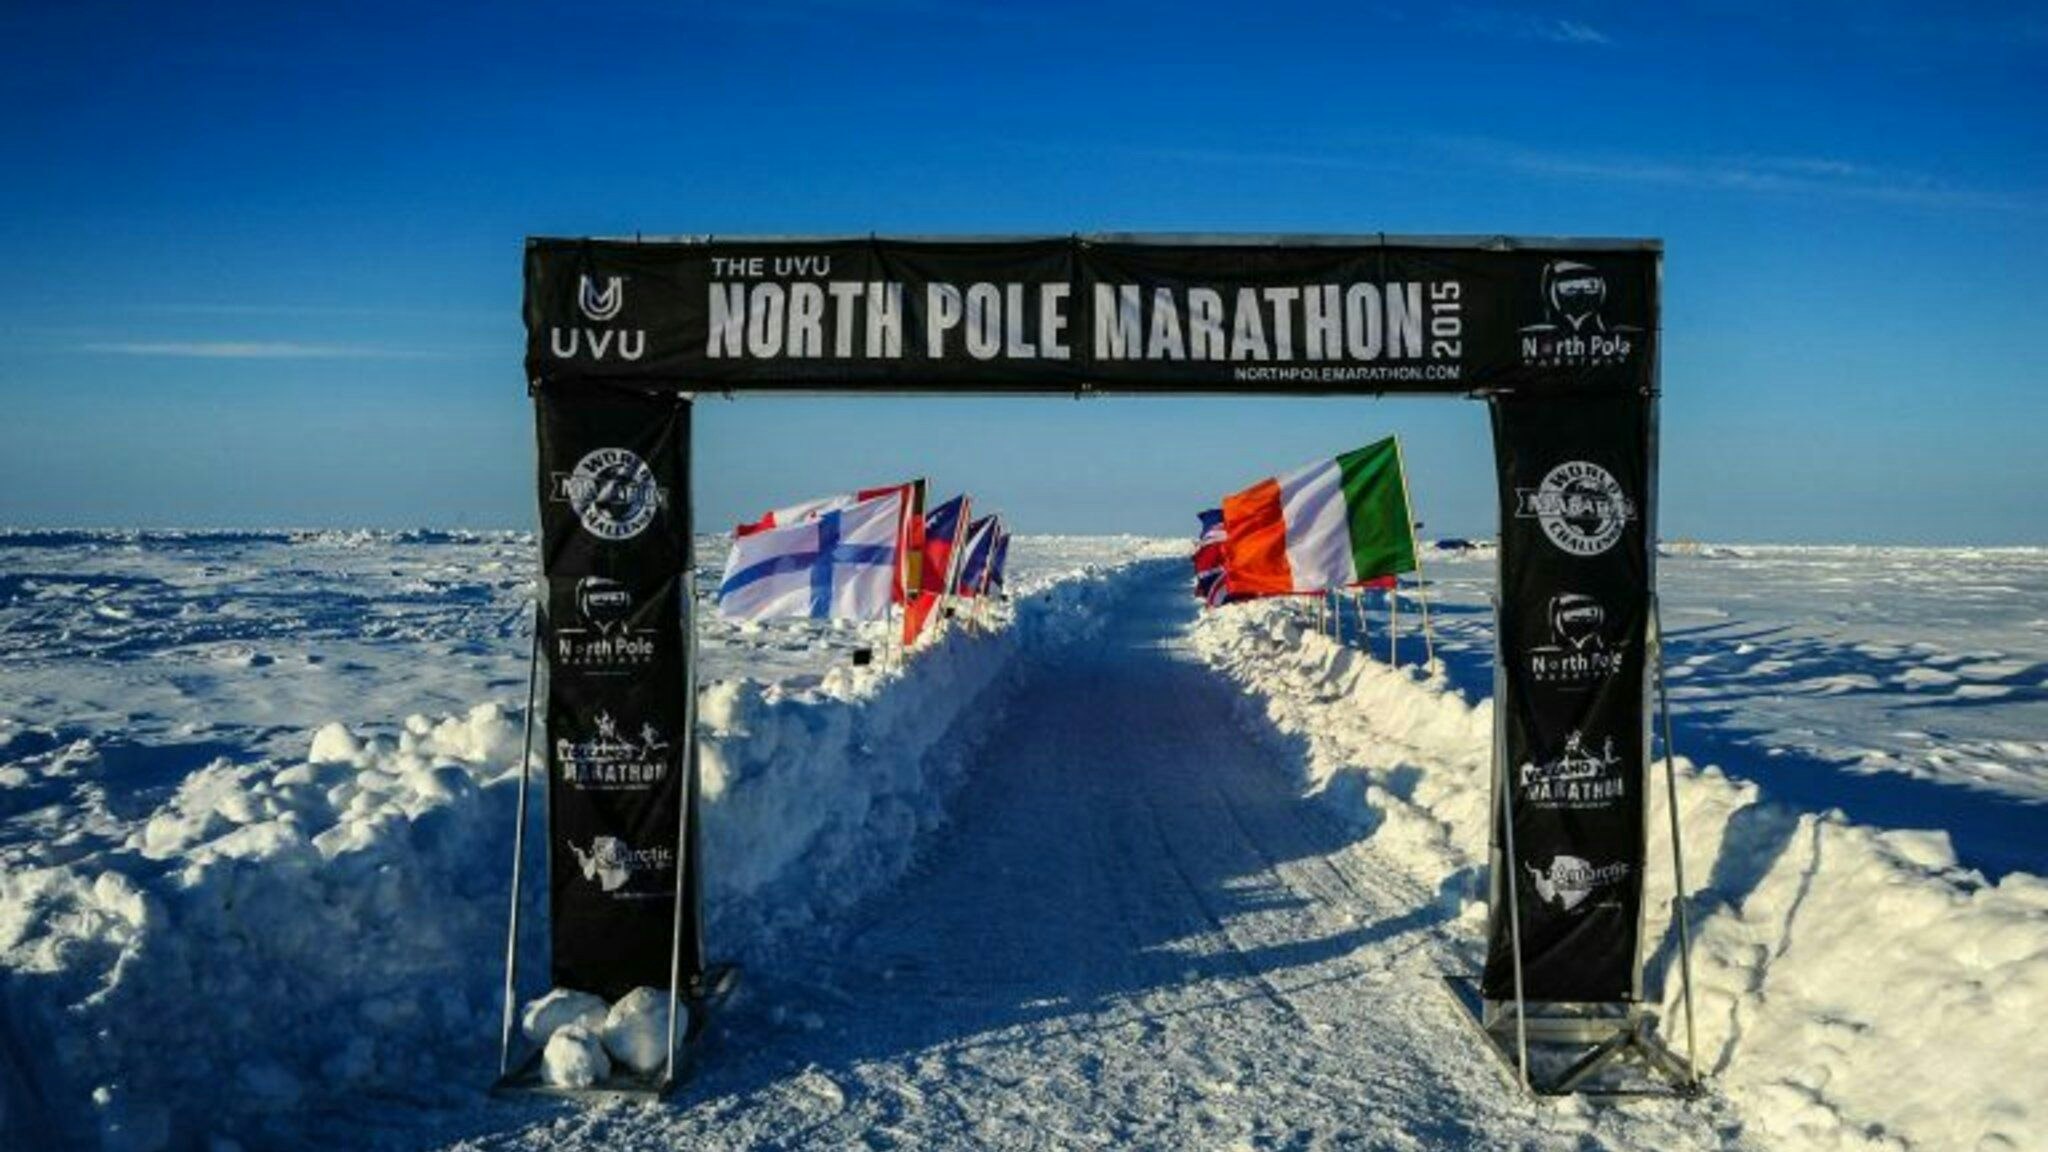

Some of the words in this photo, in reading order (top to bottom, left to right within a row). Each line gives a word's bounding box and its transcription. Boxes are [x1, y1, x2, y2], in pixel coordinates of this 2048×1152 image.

[711, 257, 764, 277] THE
[774, 256, 830, 276] UVU
[706, 281, 901, 360] NORTH
[926, 281, 1071, 361] POLE
[1093, 281, 1423, 362] MARATHON
[1431, 280, 1462, 359] 2015
[550, 327, 646, 360] UVU
[1233, 364, 1461, 381] NORTHPOLEMARATHON.COM
[582, 451, 652, 482] WORD
[559, 638, 612, 657] North
[615, 635, 654, 655] Pole
[1532, 653, 1588, 673] North
